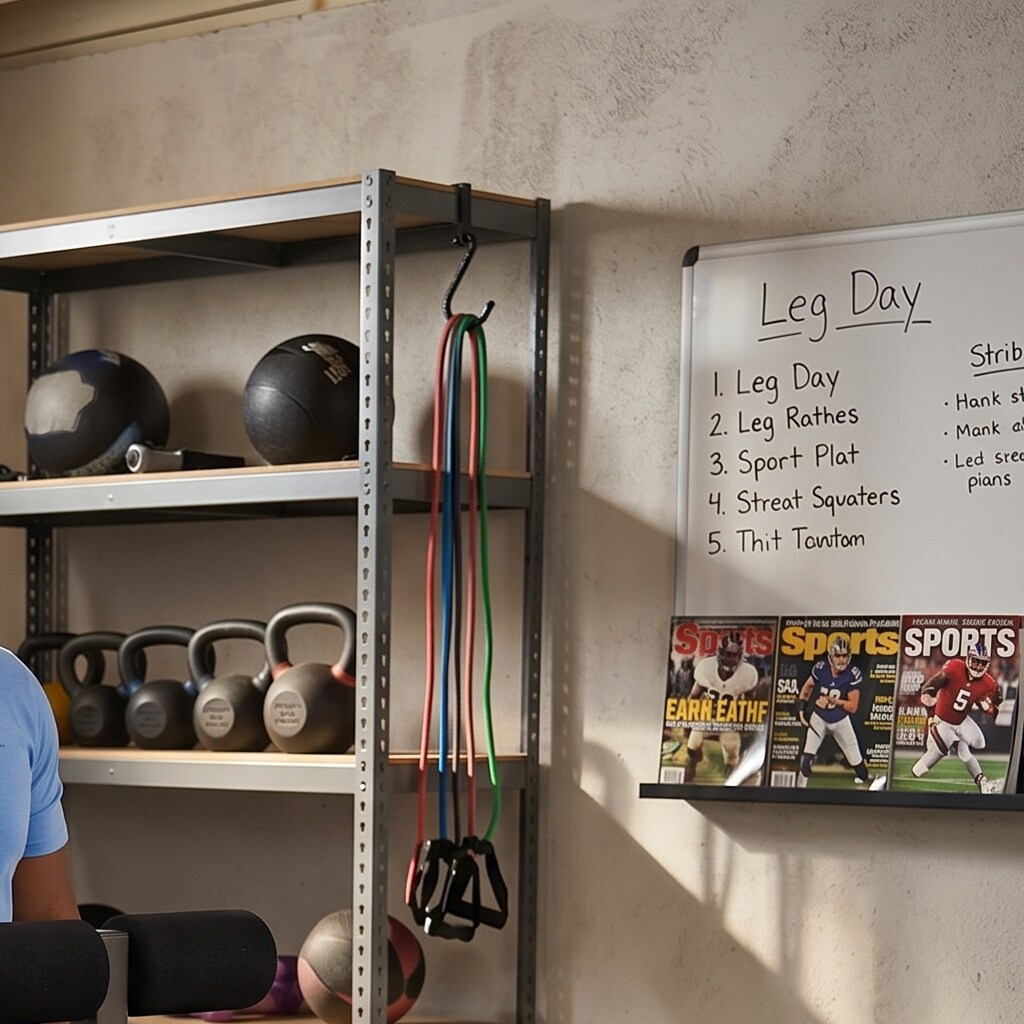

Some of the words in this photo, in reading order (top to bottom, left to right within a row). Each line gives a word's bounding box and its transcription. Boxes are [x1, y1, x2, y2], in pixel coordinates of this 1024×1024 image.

[761, 282, 827, 342] Leg
[851, 270, 922, 333] Day
[714, 371, 723, 397] 1.
[737, 369, 778, 405] Leg
[793, 362, 840, 397] Day
[956, 391, 1002, 411] Hank
[709, 413, 728, 437] 2.
[738, 411, 774, 442] Leg
[786, 406, 859, 429] Rathes
[956, 420, 1000, 440] Mank
[710, 452, 728, 476] 3.
[738, 446, 803, 482] Sport
[815, 443, 860, 467] Plat
[955, 451, 984, 468] Led
[968, 472, 1012, 493] pians
[708, 491, 726, 515] 4.
[737, 489, 803, 514] Streat
[812, 485, 901, 517] Squaters
[708, 531, 726, 555] 5.
[736, 529, 782, 552] Thit
[674, 622, 773, 657] Spts
[904, 627, 1016, 658] SPORTS
[953, 689, 971, 711] 5
